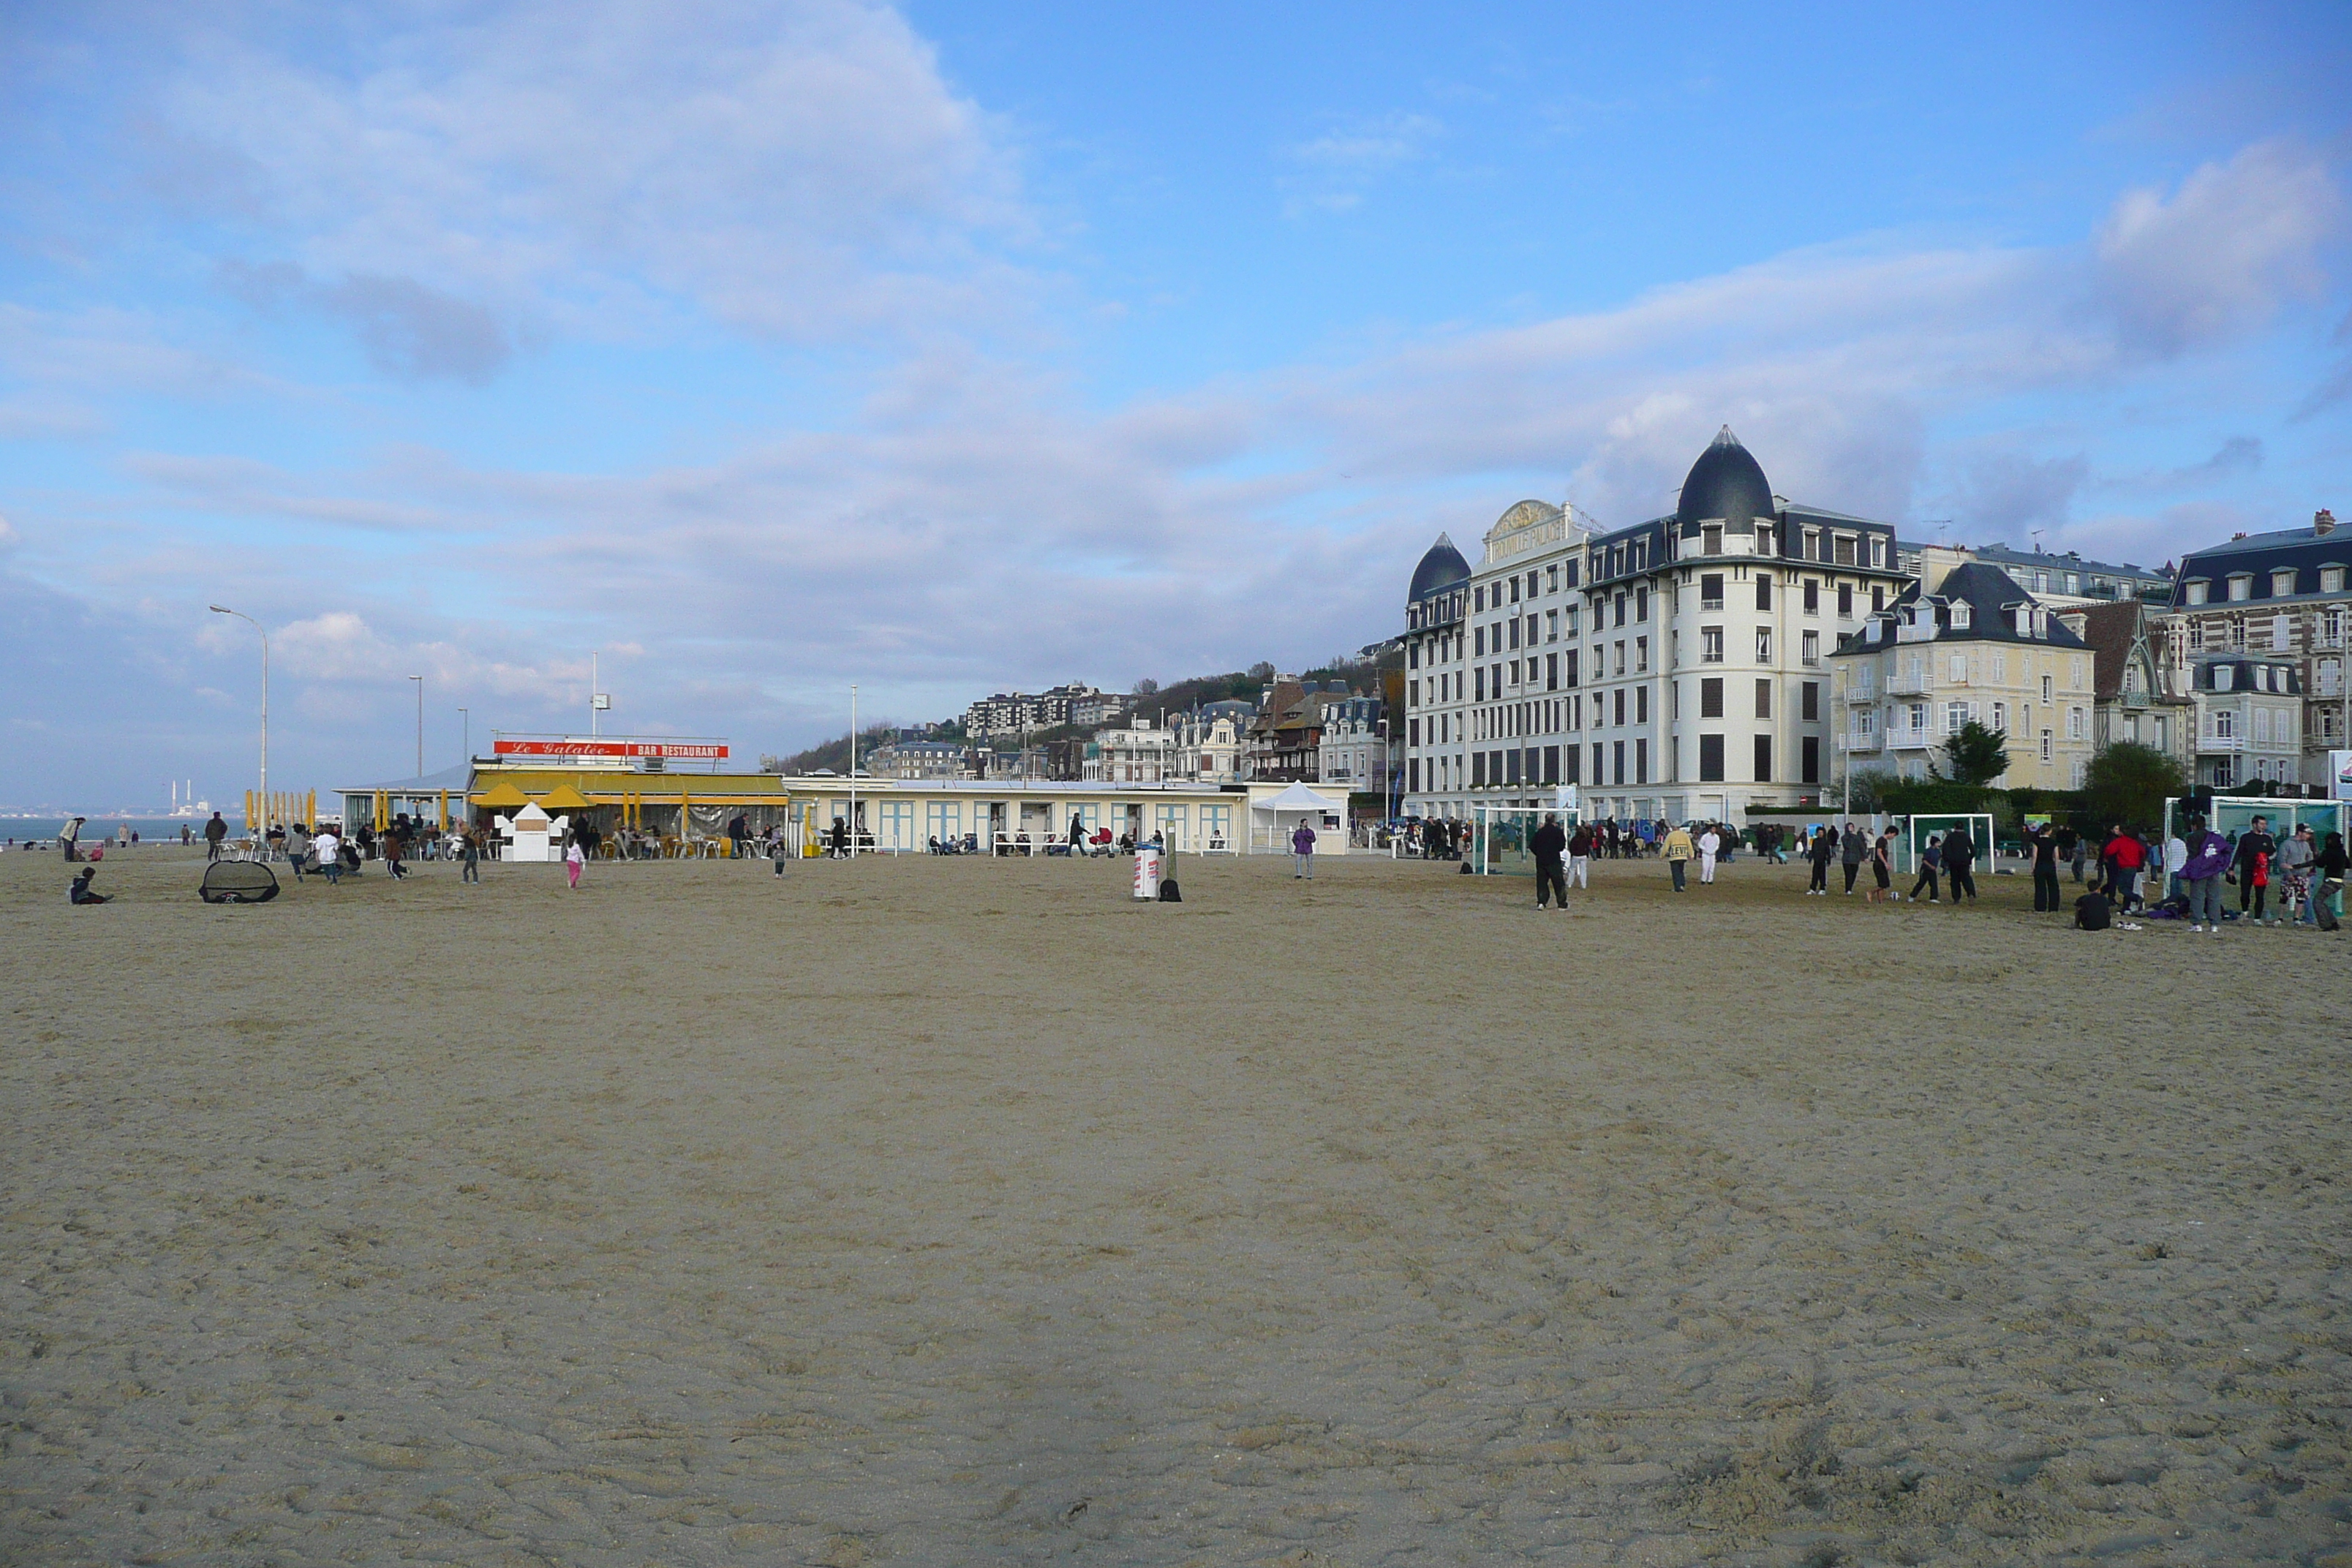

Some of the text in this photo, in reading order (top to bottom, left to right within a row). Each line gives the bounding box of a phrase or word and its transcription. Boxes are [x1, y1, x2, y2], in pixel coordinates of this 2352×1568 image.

[511, 742, 611, 755] Le Galatée
[638, 745, 720, 757] BAR RESTAURANT
